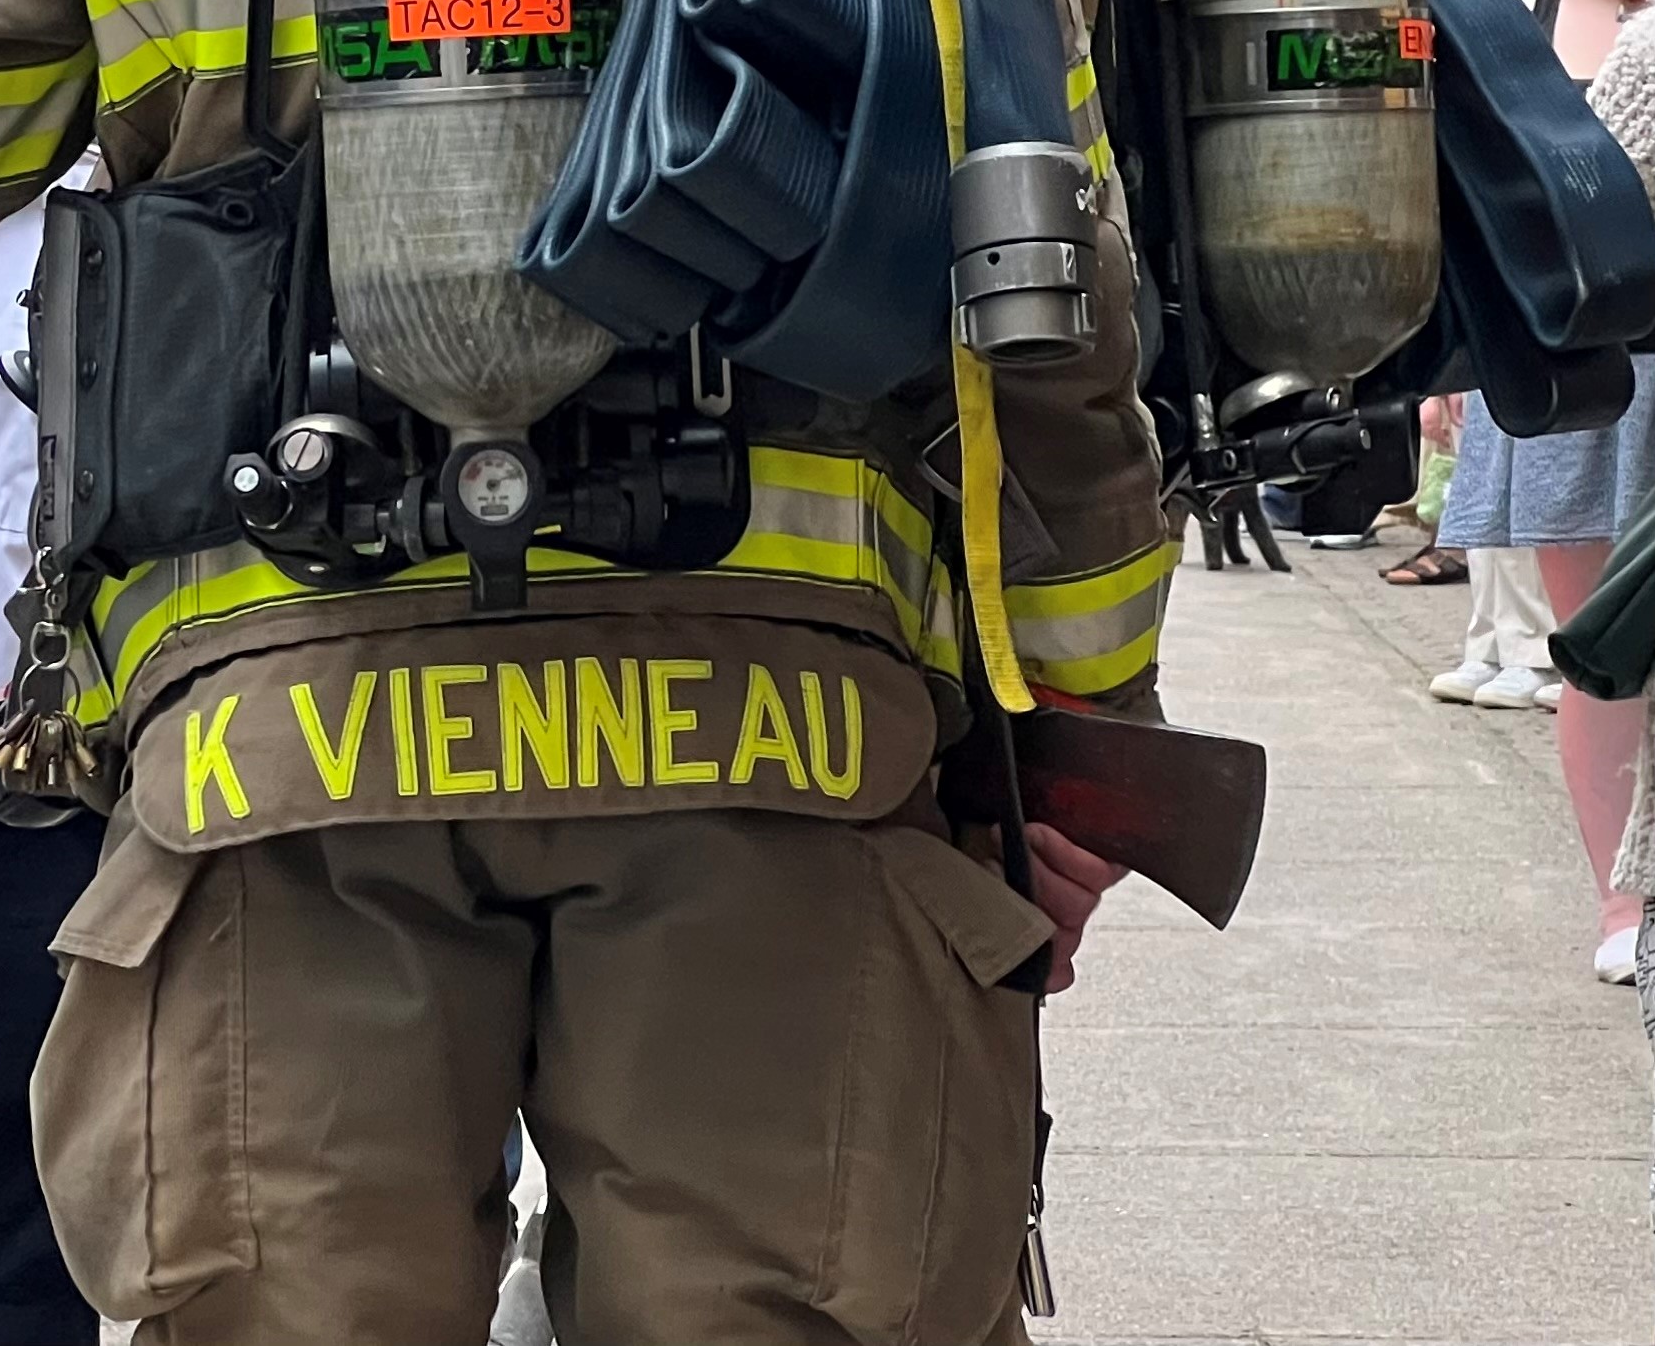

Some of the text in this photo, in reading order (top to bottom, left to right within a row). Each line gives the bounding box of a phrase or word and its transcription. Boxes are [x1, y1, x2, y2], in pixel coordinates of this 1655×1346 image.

[322, 20, 433, 78] SA
[185, 656, 862, 835] K VIENNEAU
